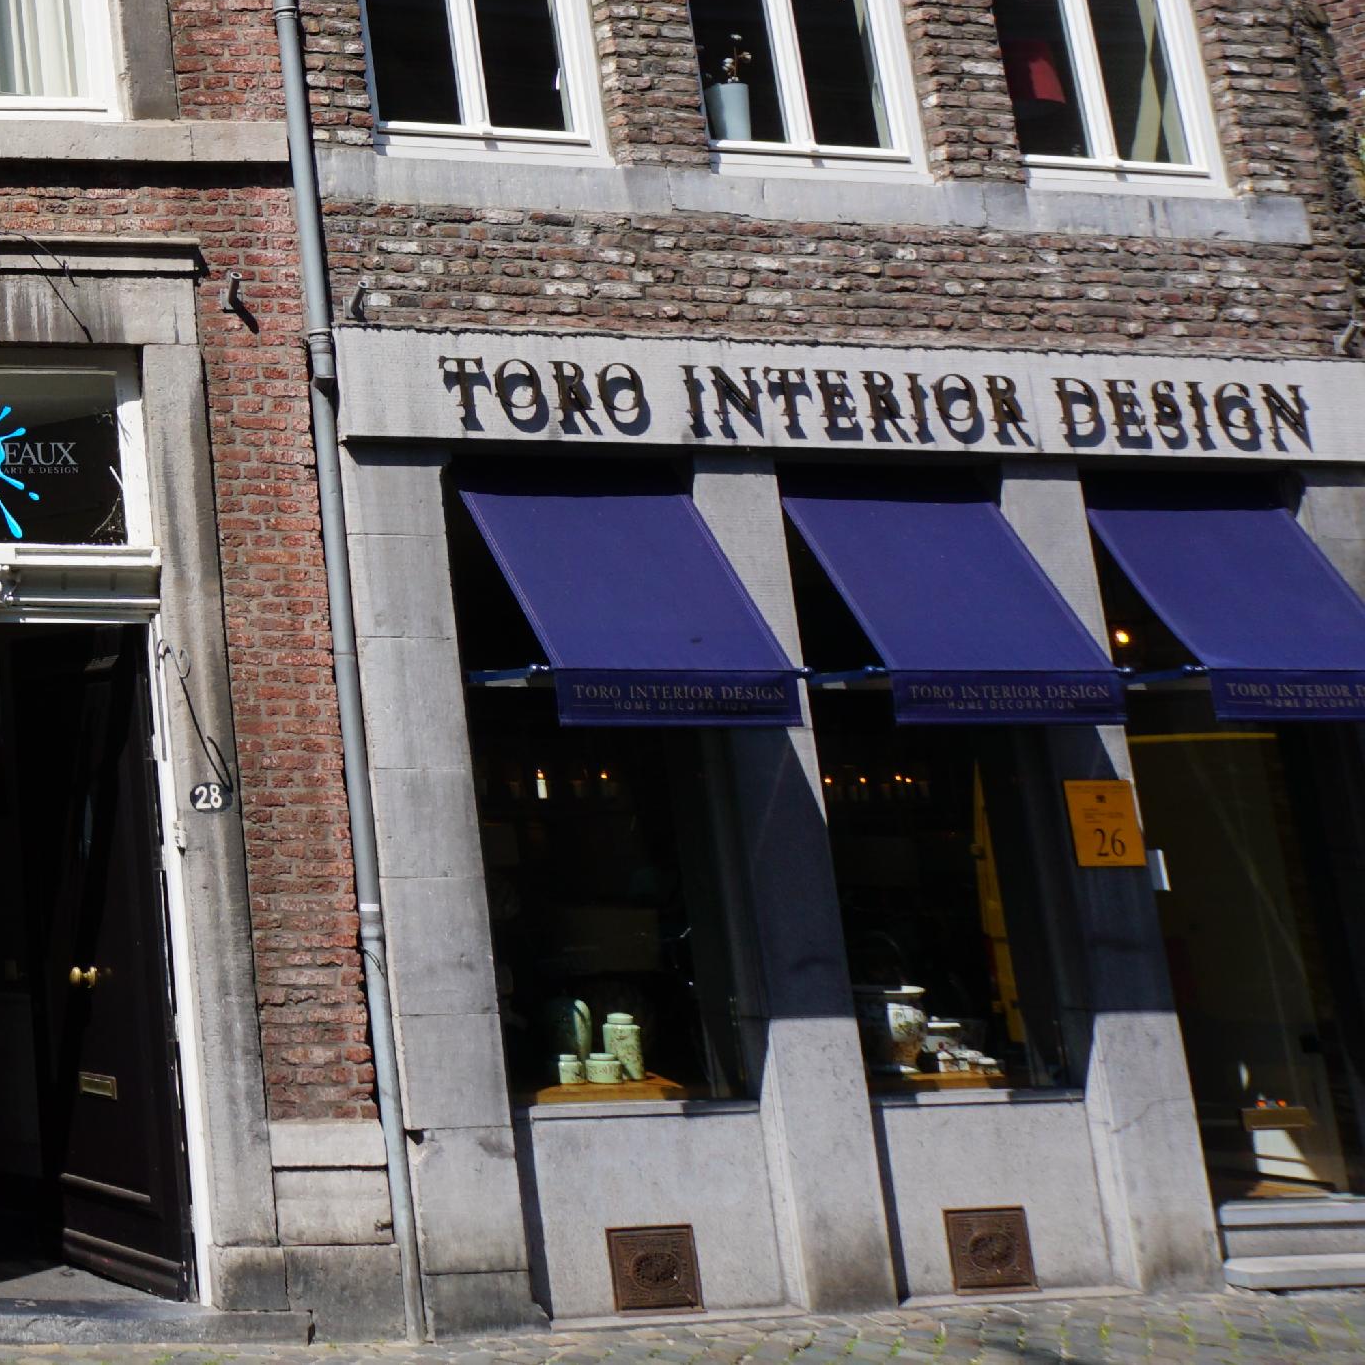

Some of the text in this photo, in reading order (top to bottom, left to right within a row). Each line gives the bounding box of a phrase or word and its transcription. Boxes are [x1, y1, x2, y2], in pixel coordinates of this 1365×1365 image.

[438, 355, 1310, 434] TORO INTERIOR DESIGN
[40, 466, 79, 474] DESIGN
[573, 684, 785, 699] TORO INTERIOR DESIGN
[909, 685, 1110, 699] TORO INTERIOR DESIGN
[1226, 682, 1271, 696] TORO
[1276, 684, 1352, 697] INTERIOR
[613, 701, 651, 710] HOME
[948, 700, 983, 710] HOME
[195, 784, 223, 809] 28
[1093, 828, 1126, 857] 26
